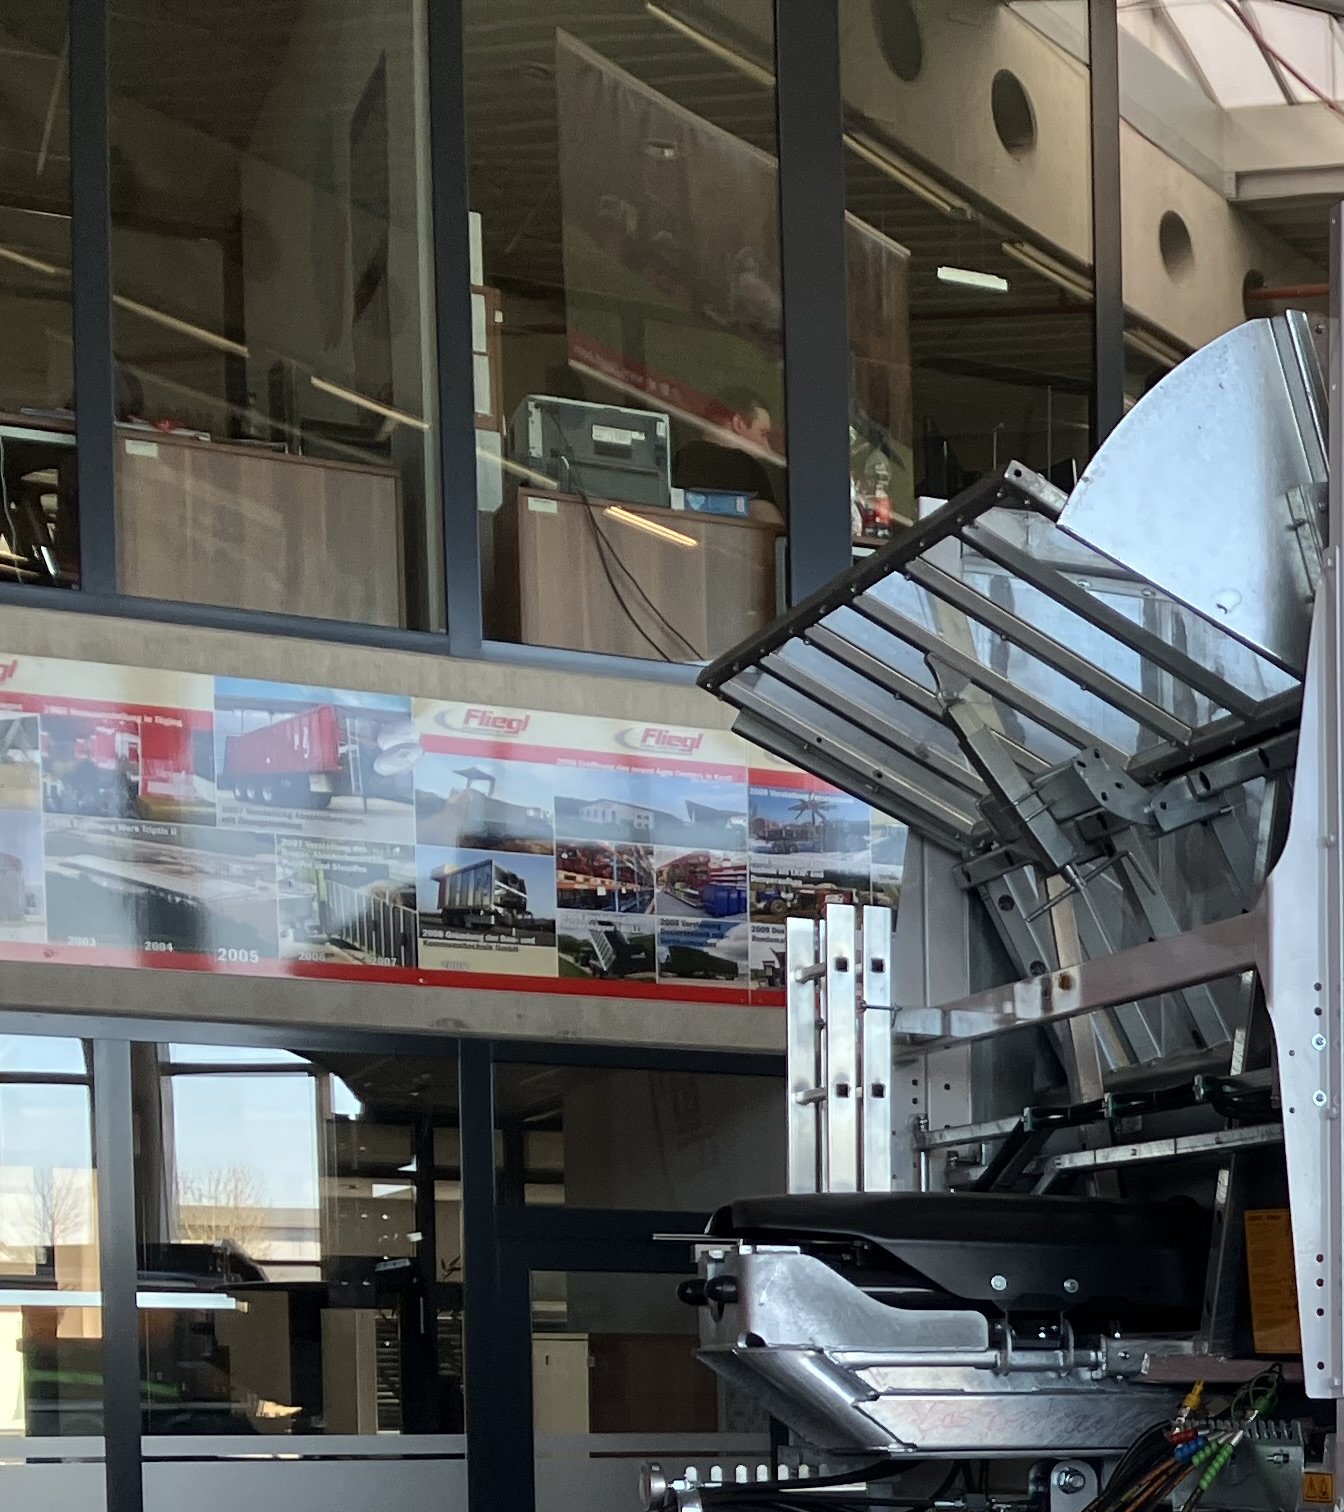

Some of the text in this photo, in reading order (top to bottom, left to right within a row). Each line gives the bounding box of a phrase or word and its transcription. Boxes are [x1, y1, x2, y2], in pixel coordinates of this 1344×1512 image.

[464, 707, 531, 735] Fliegl
[640, 727, 704, 752] Fliegl
[144, 940, 174, 953] 2004
[217, 948, 260, 964] 2005
